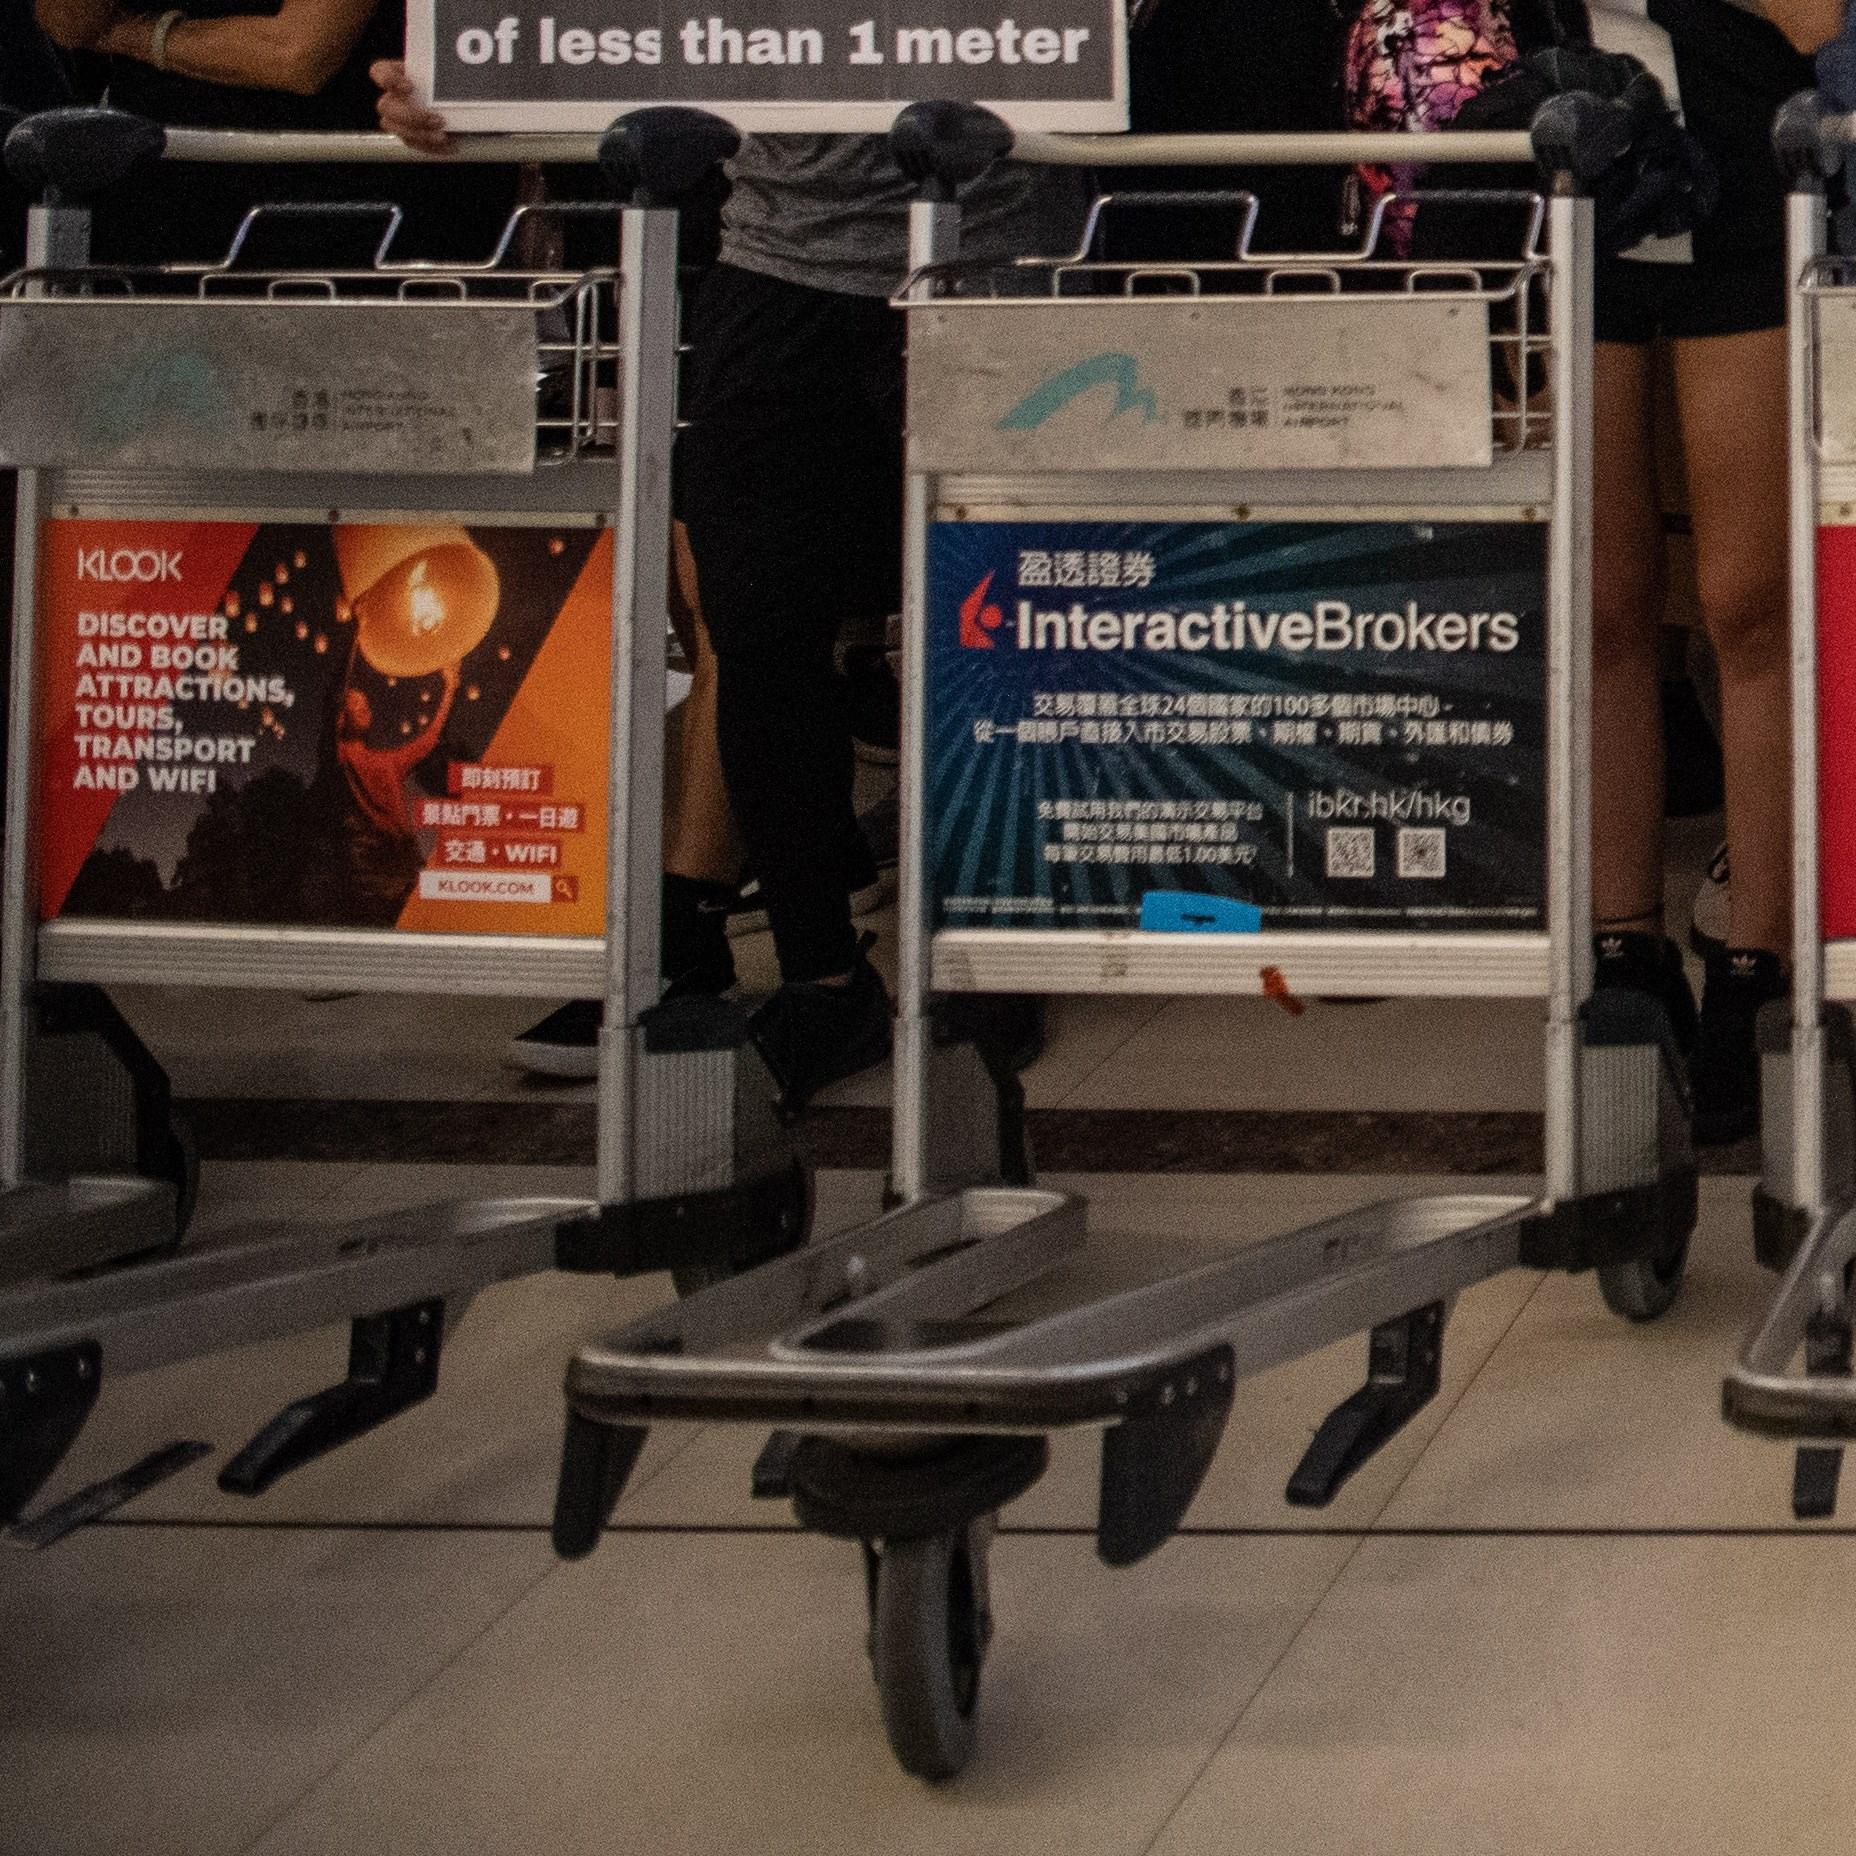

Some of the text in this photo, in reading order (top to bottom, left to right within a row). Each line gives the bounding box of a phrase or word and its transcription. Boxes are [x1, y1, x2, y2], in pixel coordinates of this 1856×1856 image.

[456, 17, 1089, 65] of less than 1 meter
[76, 548, 182, 583] KLOOK
[1017, 550, 1156, 589] 盈透證券
[77, 612, 229, 641] DISCOVER
[1016, 600, 1520, 653] InteractiveBrokers
[76, 643, 240, 673] AND BOOK
[74, 673, 296, 706] ATTRACTIONS,
[74, 704, 184, 736] TOURS,
[74, 735, 256, 763] TRANSPORT
[73, 765, 218, 795] AND WIFI
[462, 767, 541, 791] 即刻預訂
[1308, 790, 1472, 826] ibkr.hk/hkg
[438, 879, 534, 894] KLOOK.COM
